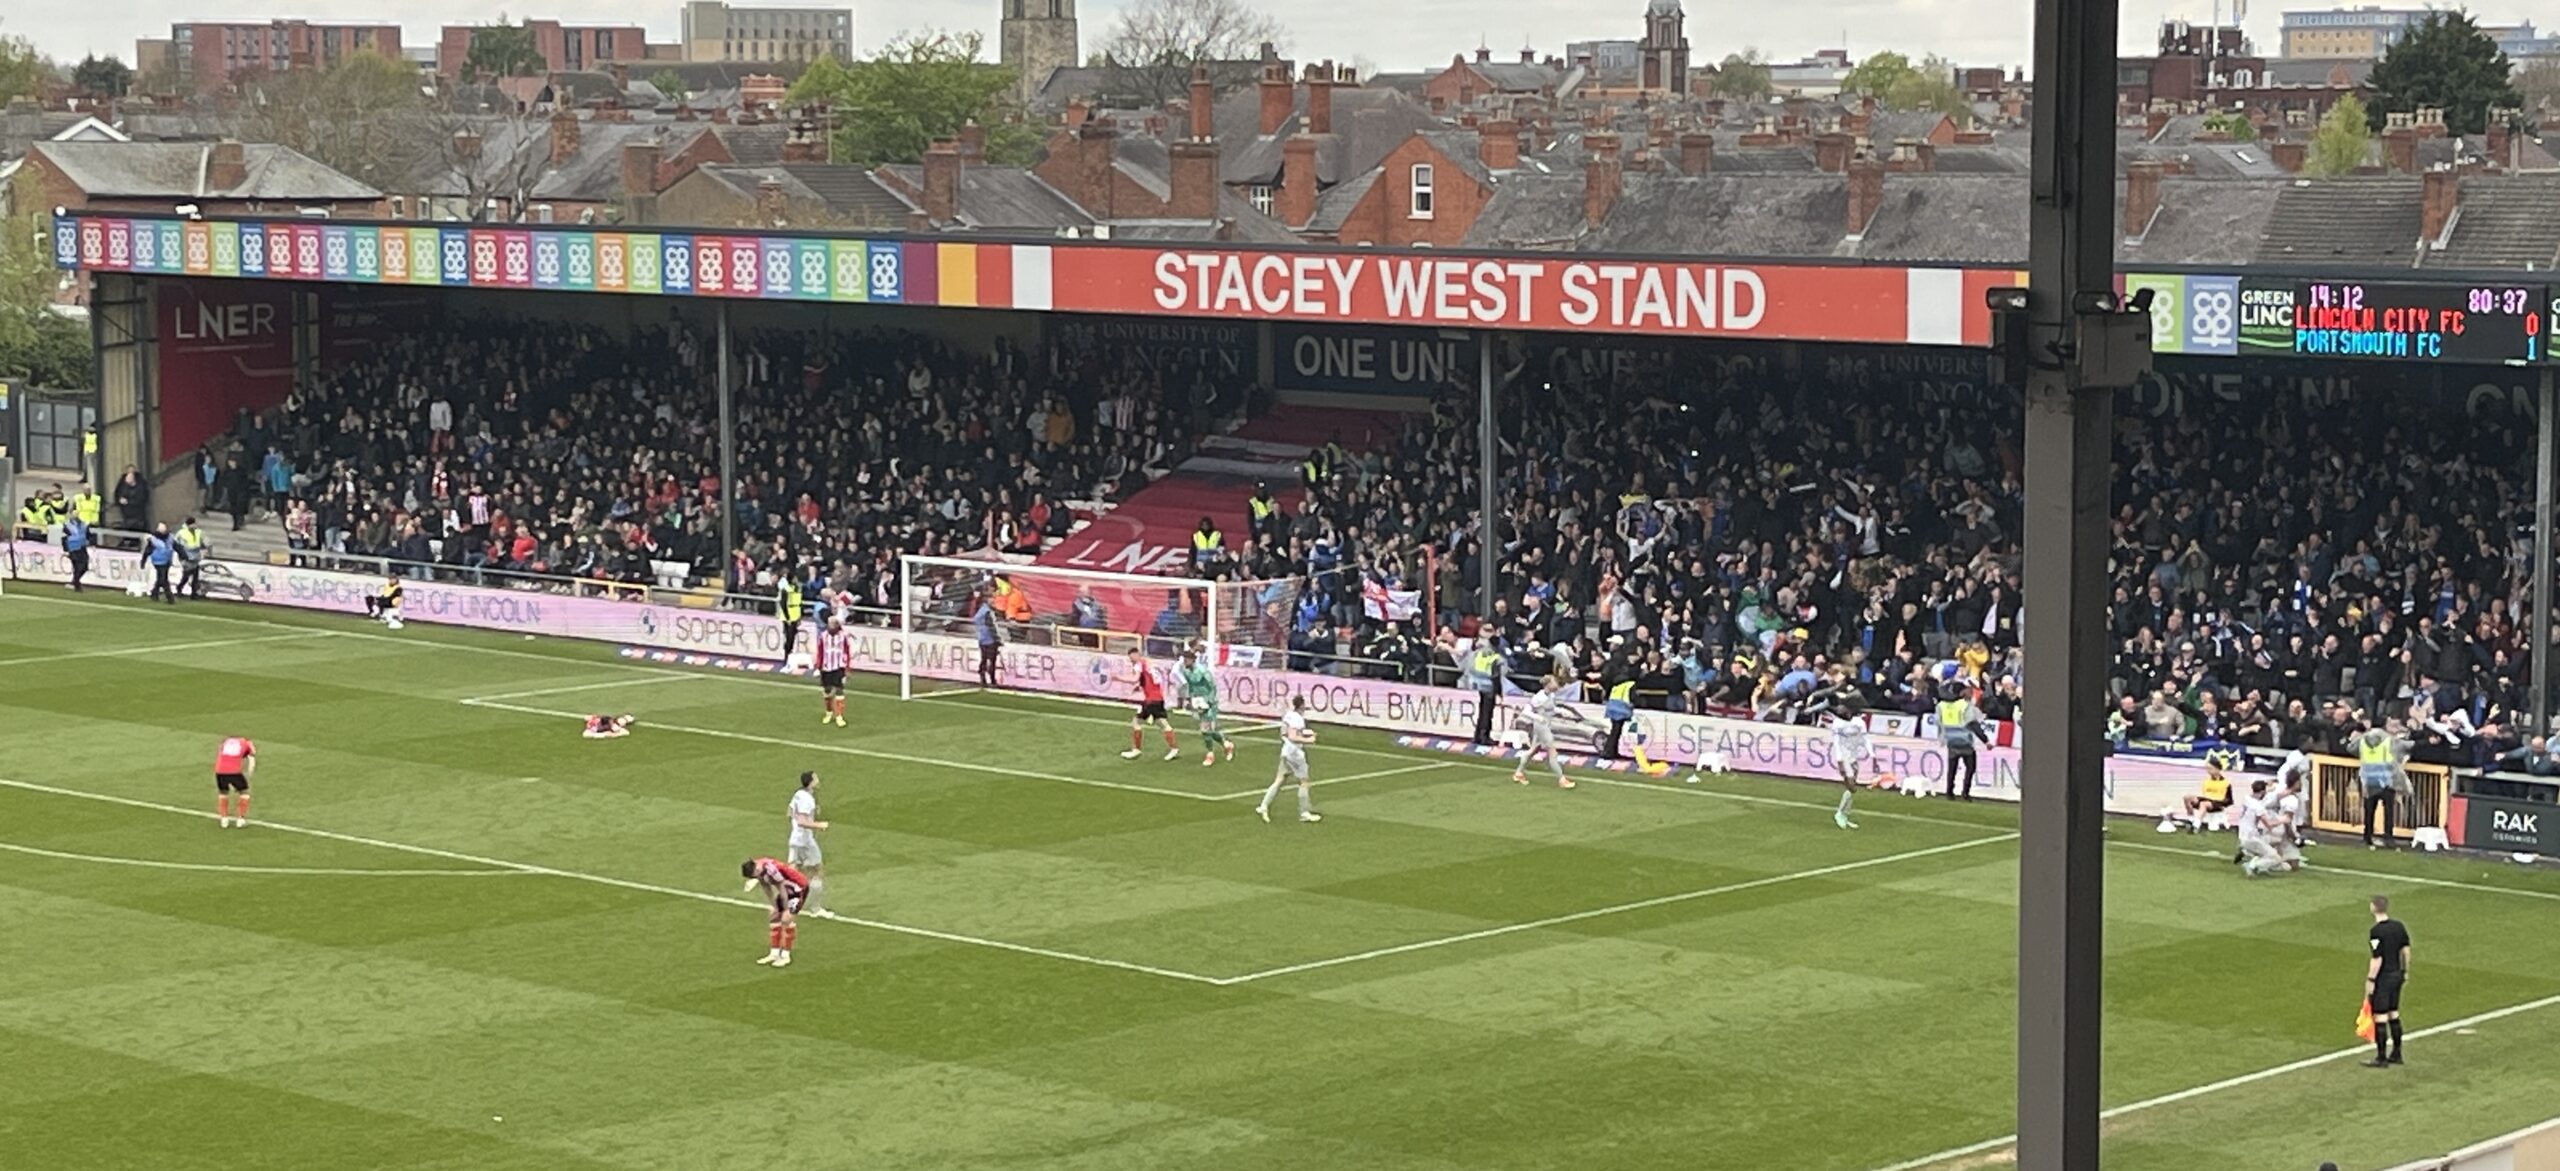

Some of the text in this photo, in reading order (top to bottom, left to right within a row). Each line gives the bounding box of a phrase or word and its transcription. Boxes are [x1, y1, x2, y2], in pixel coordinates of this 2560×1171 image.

[1153, 251, 1767, 330] STACEY WEST STAND
[2241, 290, 2294, 306] GREEN
[2310, 285, 2528, 314] 14:12 80:37
[175, 300, 275, 342] LNER
[2241, 305, 2293, 326] LINC
[2296, 304, 2376, 332] LINCOLN
[2383, 308, 2430, 333] CITY
[2440, 310, 2465, 336] FC
[2526, 312, 2540, 336] 0
[1102, 323, 1241, 344] UNIVERSITY OF
[2295, 329, 2536, 360] PORTSMOUTH FC 1
[1293, 335, 1376, 378] ONE
[460, 595, 541, 624] LINCOLN
[676, 616, 749, 652] SOPER,
[754, 624, 811, 653] YOR
[890, 639, 944, 670] BMW
[952, 646, 1057, 681] REAILER
[1223, 675, 1290, 708] YOUR
[1297, 682, 1380, 719] LOCAL
[1388, 692, 1450, 724] BMW
[1678, 723, 1798, 765] SEARCH
[1920, 750, 1945, 783] O
[2493, 810, 2538, 833] RAK
